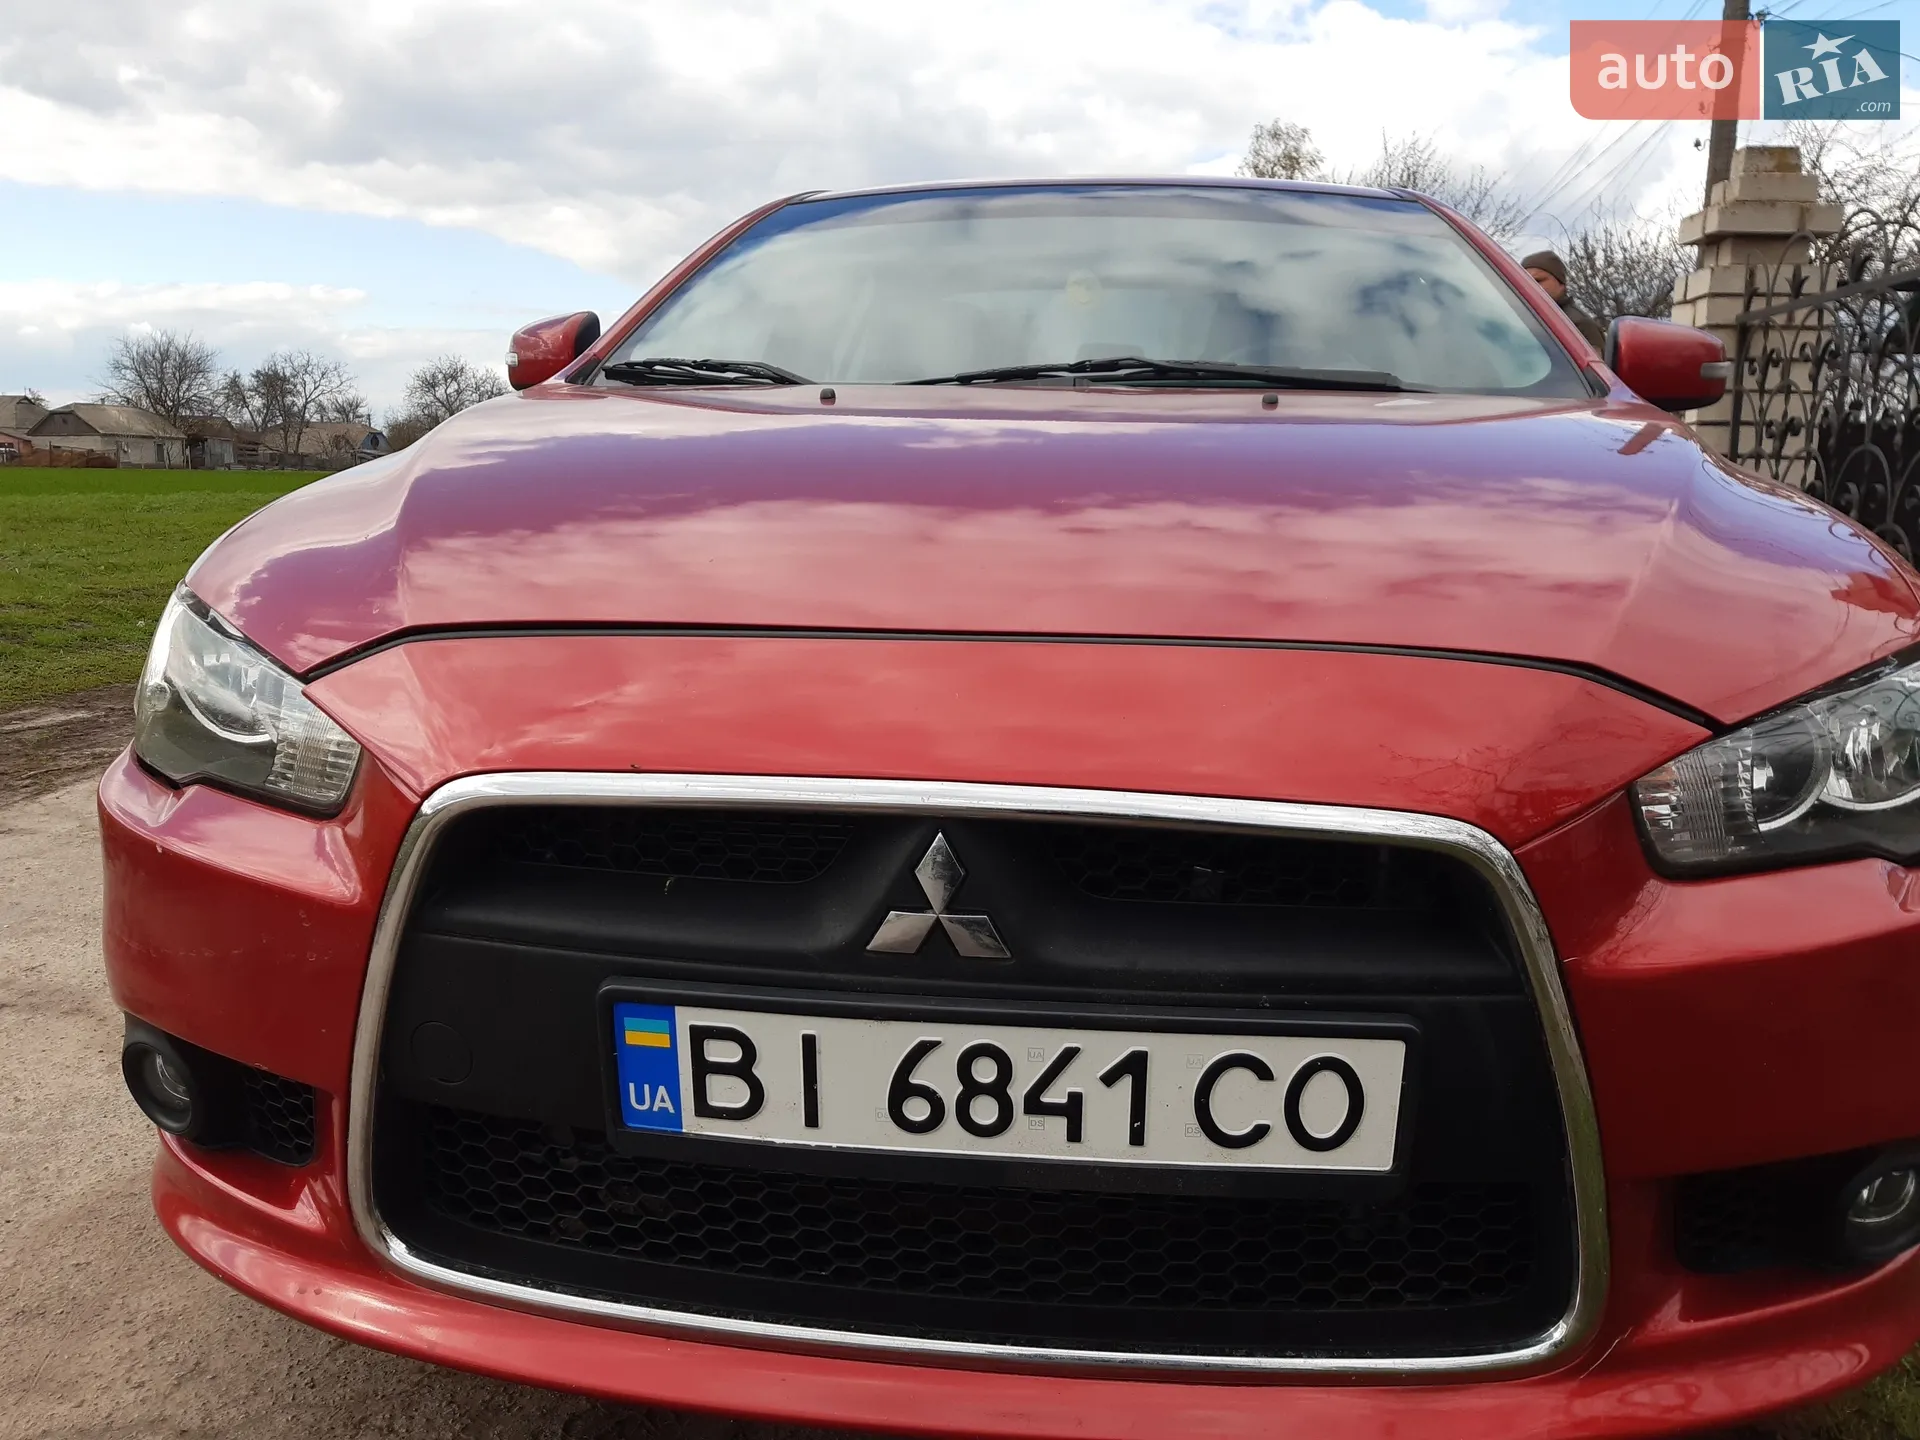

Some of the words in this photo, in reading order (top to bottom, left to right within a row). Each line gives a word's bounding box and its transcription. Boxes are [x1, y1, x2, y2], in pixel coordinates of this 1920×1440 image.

[628, 1082, 676, 1114] UA
[688, 1023, 820, 1128] BI
[887, 1039, 1149, 1147] 6841
[1193, 1051, 1366, 1153] CO
